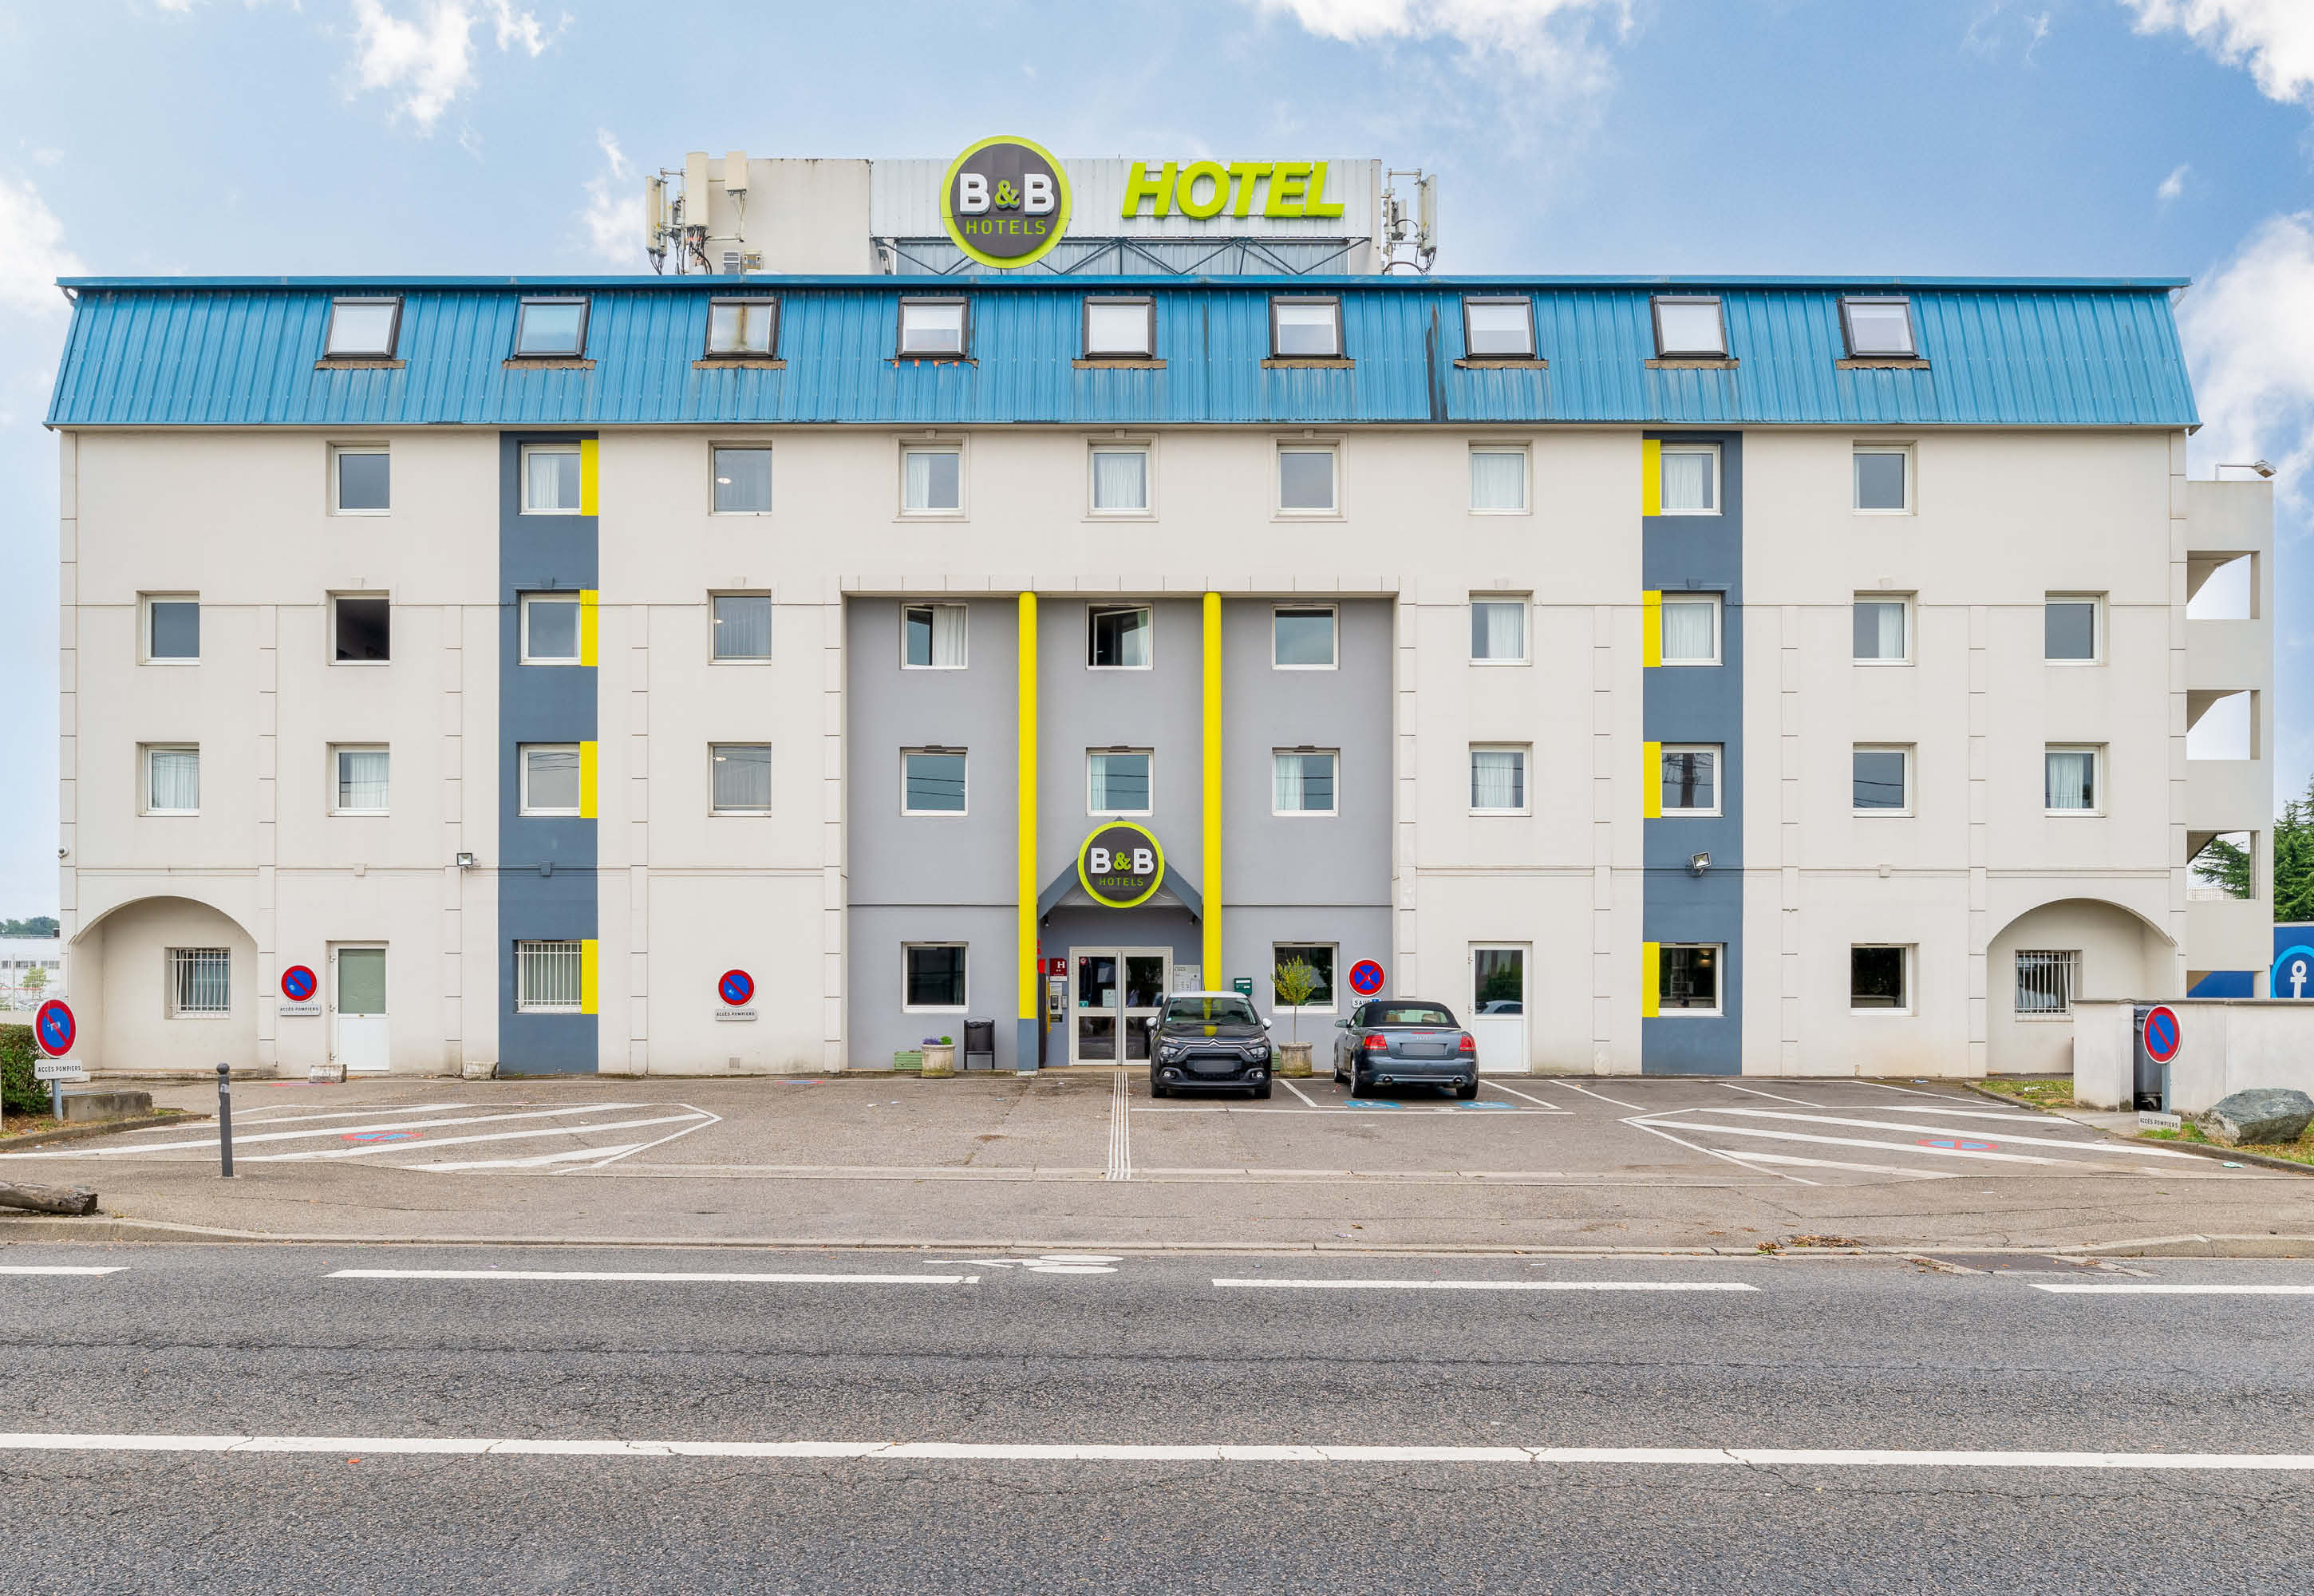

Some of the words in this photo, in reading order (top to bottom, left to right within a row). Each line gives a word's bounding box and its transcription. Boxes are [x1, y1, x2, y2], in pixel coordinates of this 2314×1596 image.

[959, 173, 1055, 215] B&B
[1121, 161, 1345, 219] HOTEL
[965, 219, 1046, 235] HOTELS
[1091, 848, 1155, 874] B&B
[1099, 877, 1143, 887] HOTELS
[2154, 1120, 2178, 1128] POMPIERS
